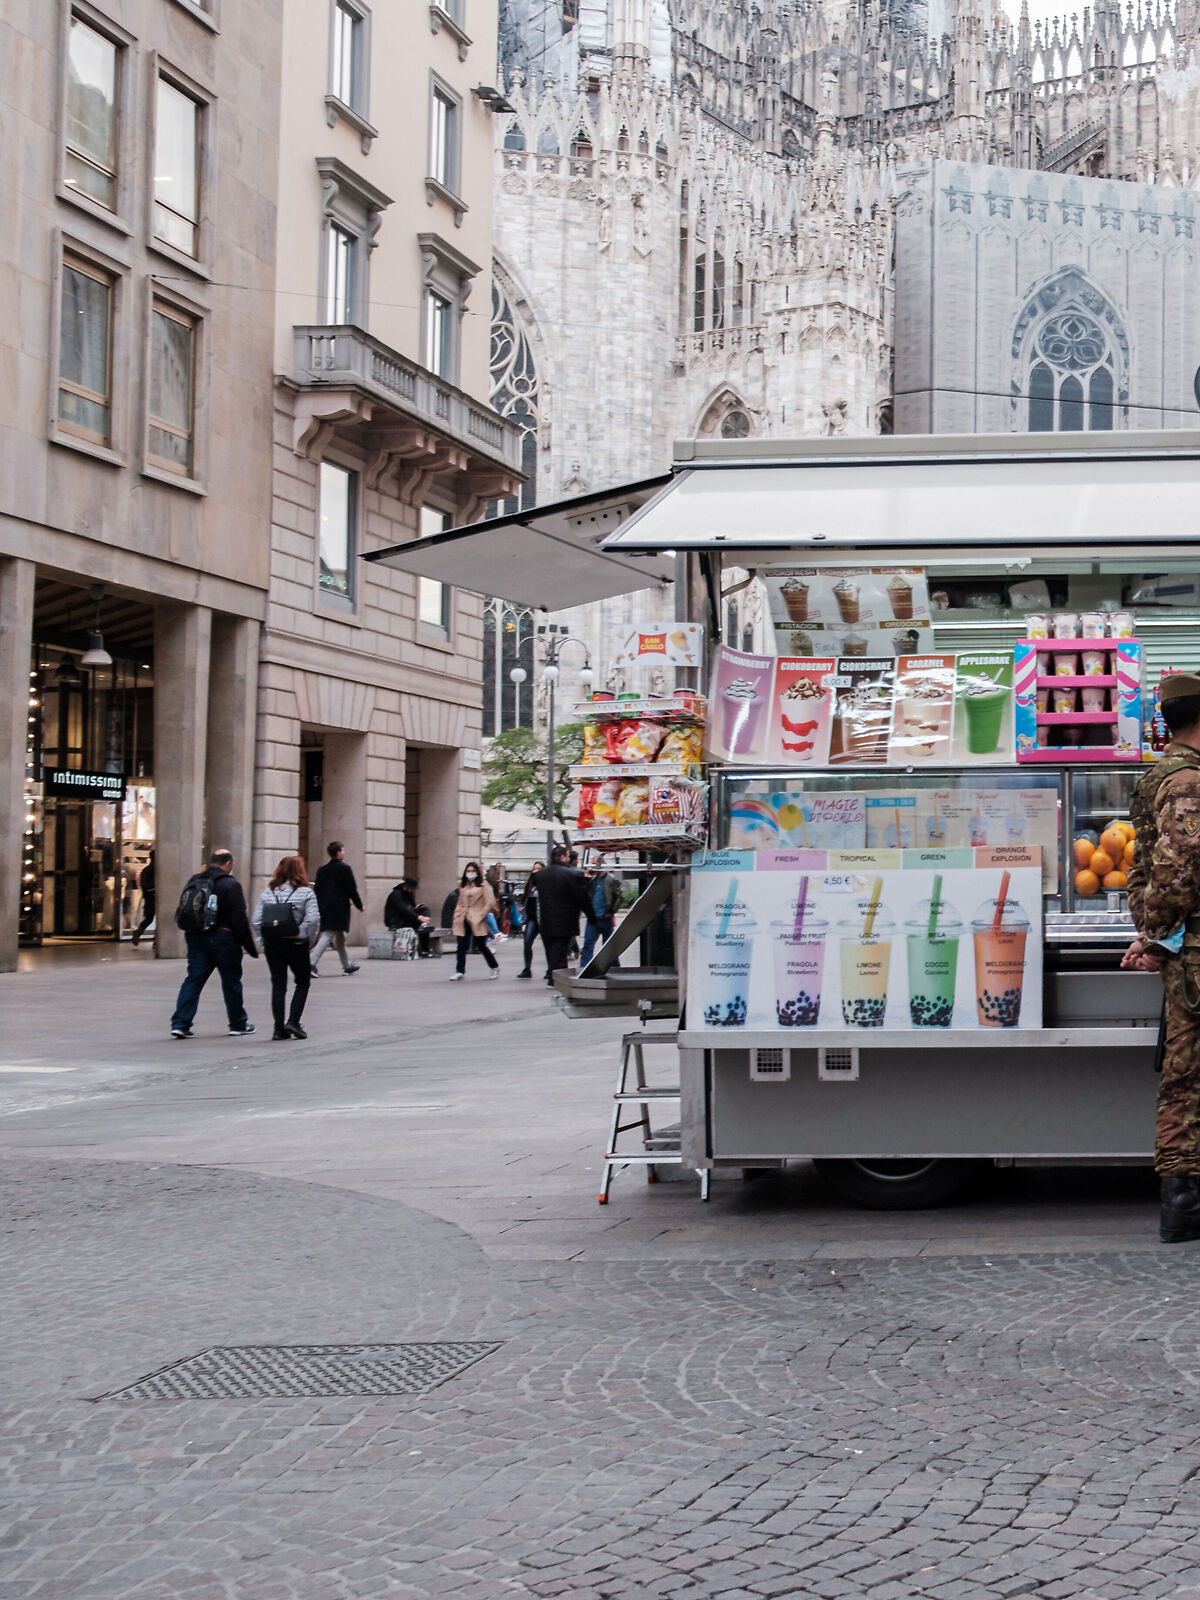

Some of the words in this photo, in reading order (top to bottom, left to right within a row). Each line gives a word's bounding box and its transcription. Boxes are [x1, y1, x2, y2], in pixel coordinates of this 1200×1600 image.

[840, 661, 893, 671] CIOKOSHAKE
[906, 659, 944, 669] CARAMEL
[959, 656, 1011, 666] APPLESHAKE
[780, 662, 833, 671] CIOKOBERRY
[53, 771, 122, 788] intimissimi
[813, 799, 859, 811] MAGIE
[824, 876, 842, 886] 4,50
[844, 876, 851, 885] €
